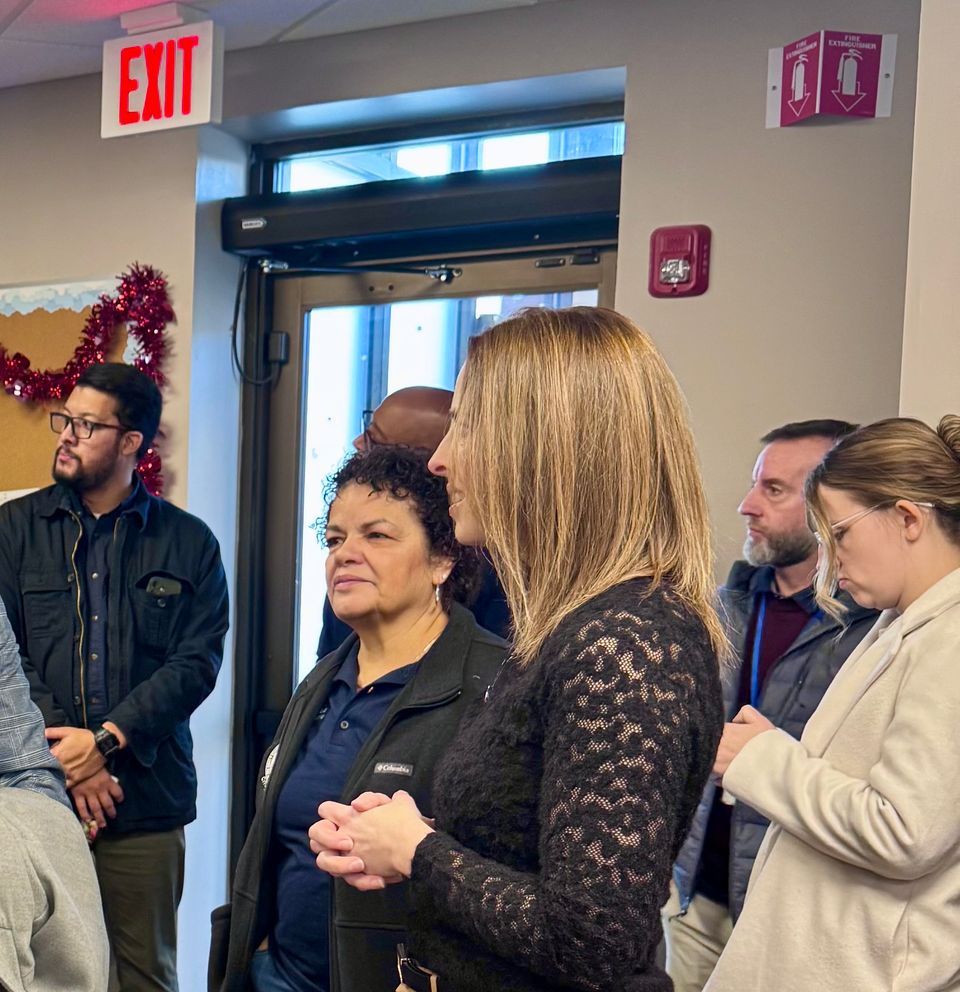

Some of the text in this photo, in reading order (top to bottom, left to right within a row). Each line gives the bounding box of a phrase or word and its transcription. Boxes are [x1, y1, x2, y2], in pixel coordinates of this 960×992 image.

[796, 40, 807, 49] FIRE
[828, 39, 876, 50] EXTINGUISHER
[119, 35, 199, 125] EXIT
